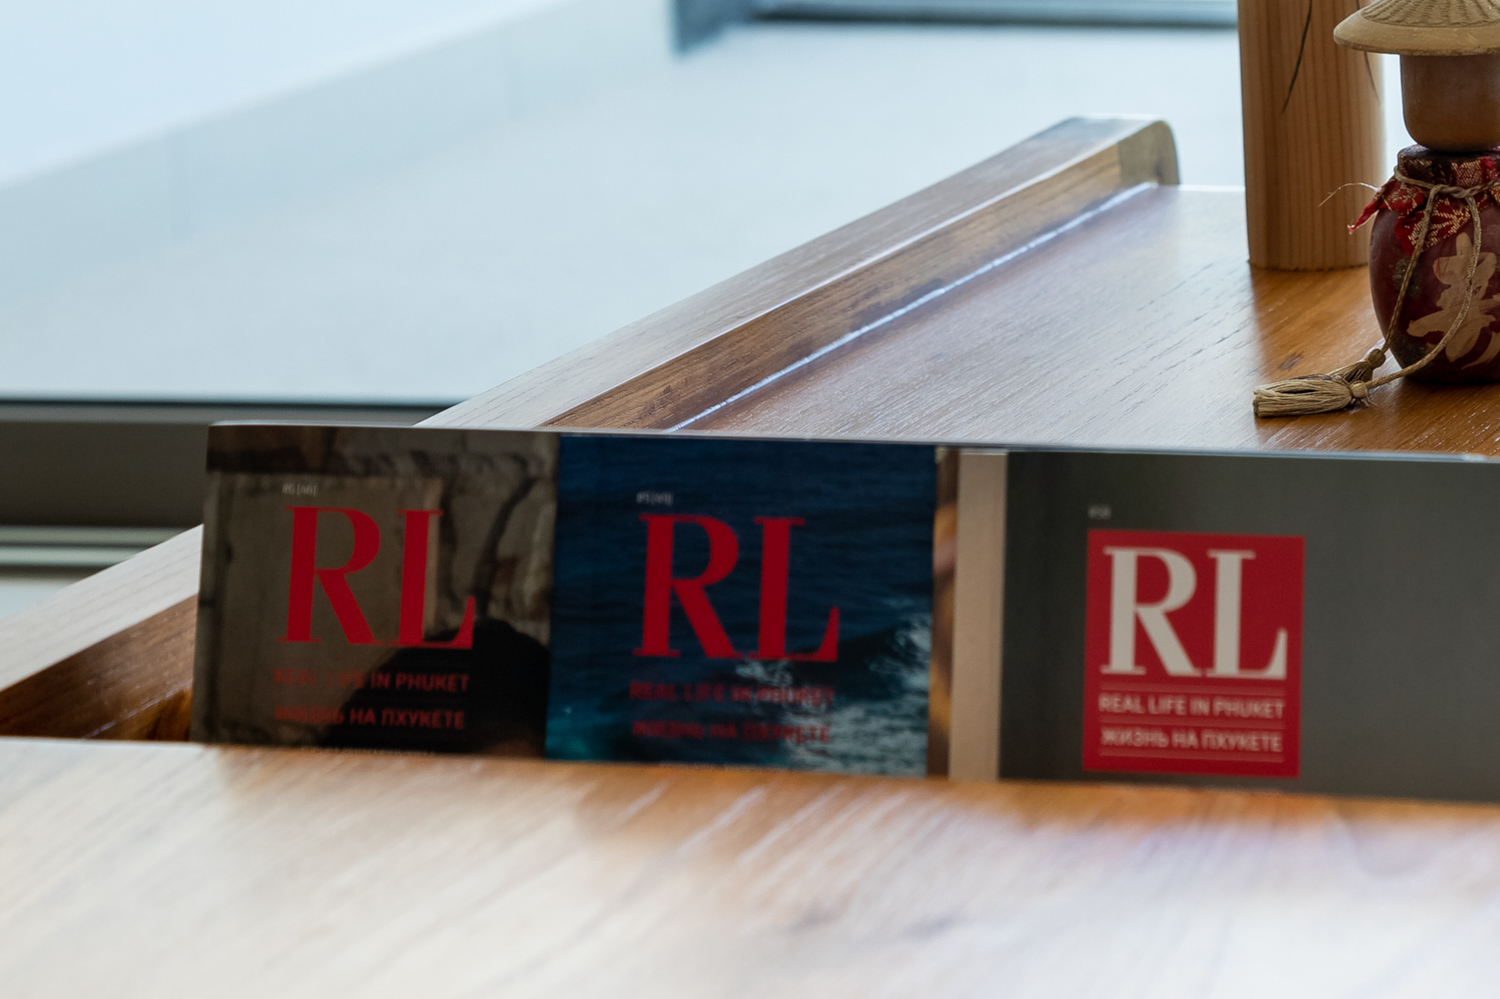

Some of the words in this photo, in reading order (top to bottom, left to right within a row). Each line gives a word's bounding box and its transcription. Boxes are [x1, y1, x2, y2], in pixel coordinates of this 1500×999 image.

[276, 506, 475, 649] RL
[633, 514, 840, 662] RL
[1100, 547, 1288, 680] RL
[273, 668, 318, 687] REAL
[371, 673, 391, 689] IN
[395, 673, 469, 692] PHUKET
[350, 708, 376, 725] НА
[382, 709, 465, 730] ПХУКЕТЕ
[1098, 692, 1145, 714] REAL
[1148, 695, 1187, 715] LIFE
[1190, 697, 1210, 716] IN
[1213, 697, 1285, 719] PHUKET
[1101, 727, 1169, 748] ЖИЗНЬ
[1171, 729, 1199, 749] НА
[1201, 729, 1283, 753] ПХУКЕТЕ
